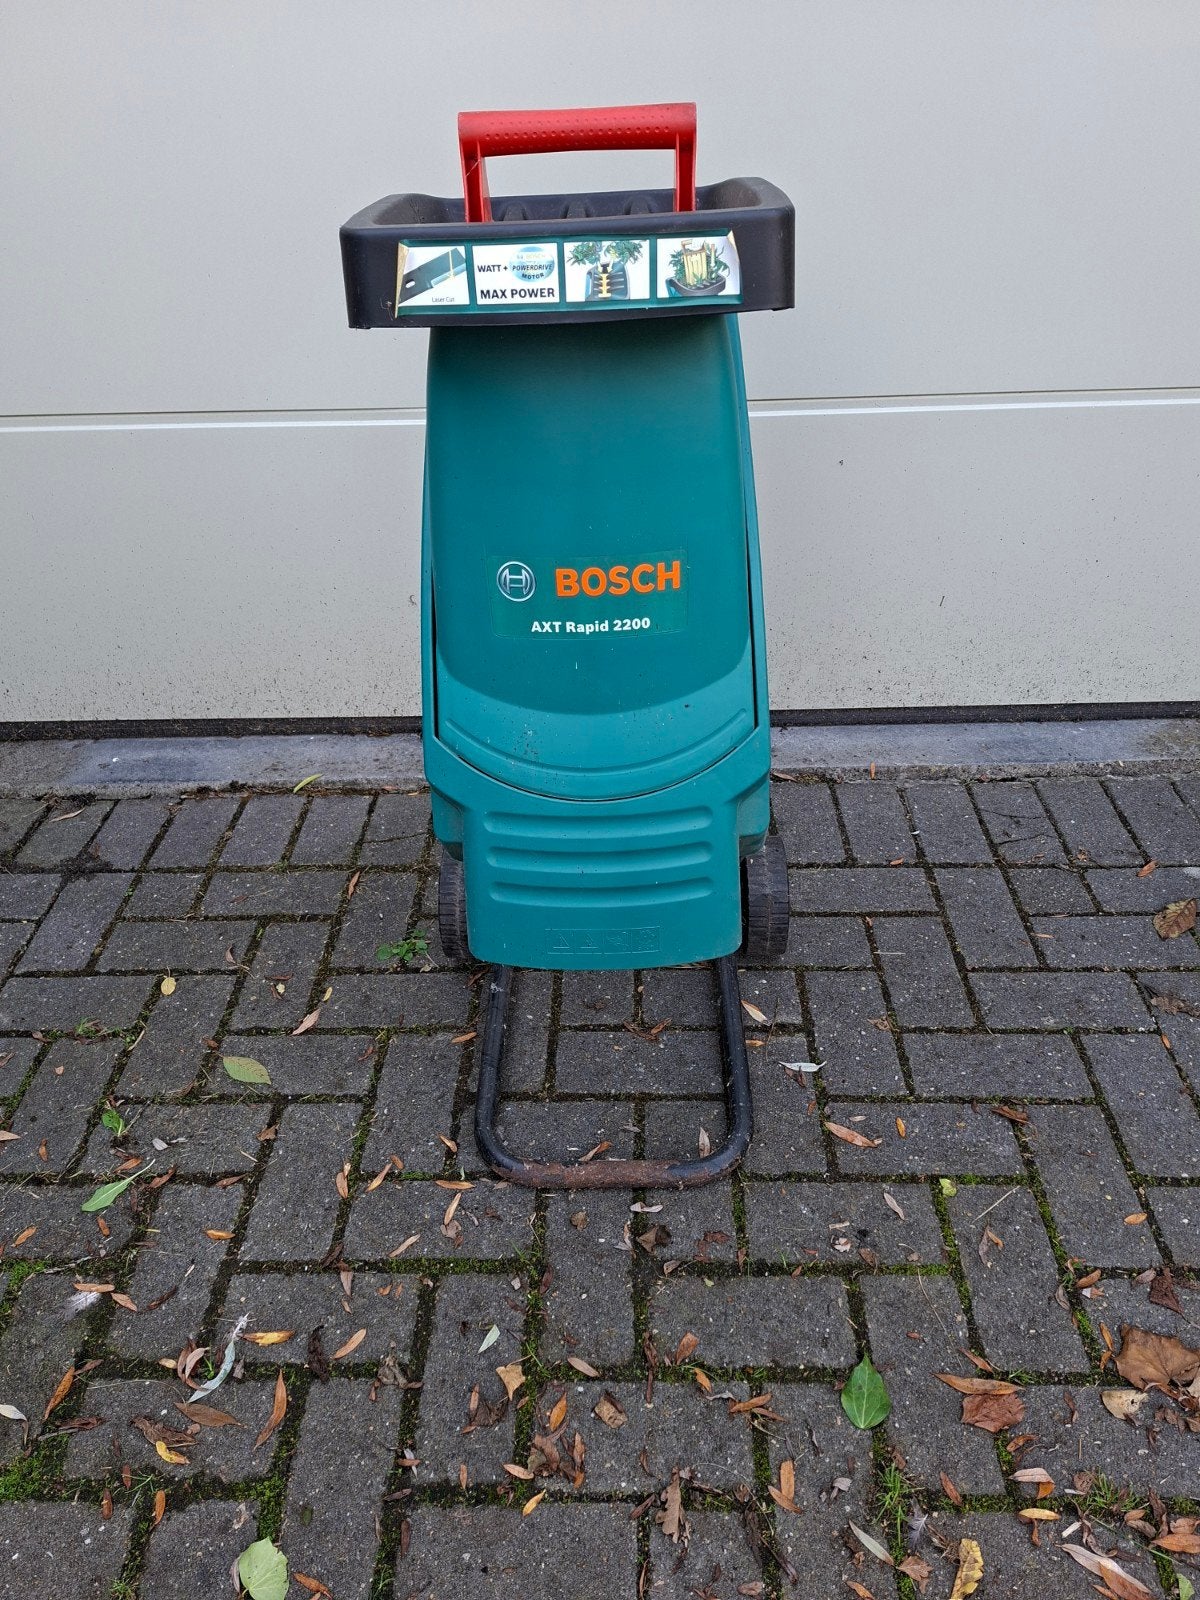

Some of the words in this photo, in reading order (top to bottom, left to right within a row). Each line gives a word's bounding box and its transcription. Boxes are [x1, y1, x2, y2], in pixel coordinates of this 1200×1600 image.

[477, 264, 502, 273] WATT
[512, 263, 553, 271] POWERDRIVE
[521, 272, 545, 280] MOTOR
[480, 288, 507, 300] MAX
[510, 287, 555, 299] POWER
[555, 560, 681, 597] BOSCH
[531, 621, 562, 633] AXT
[565, 620, 609, 635] Rapid
[613, 617, 651, 631] 2200
